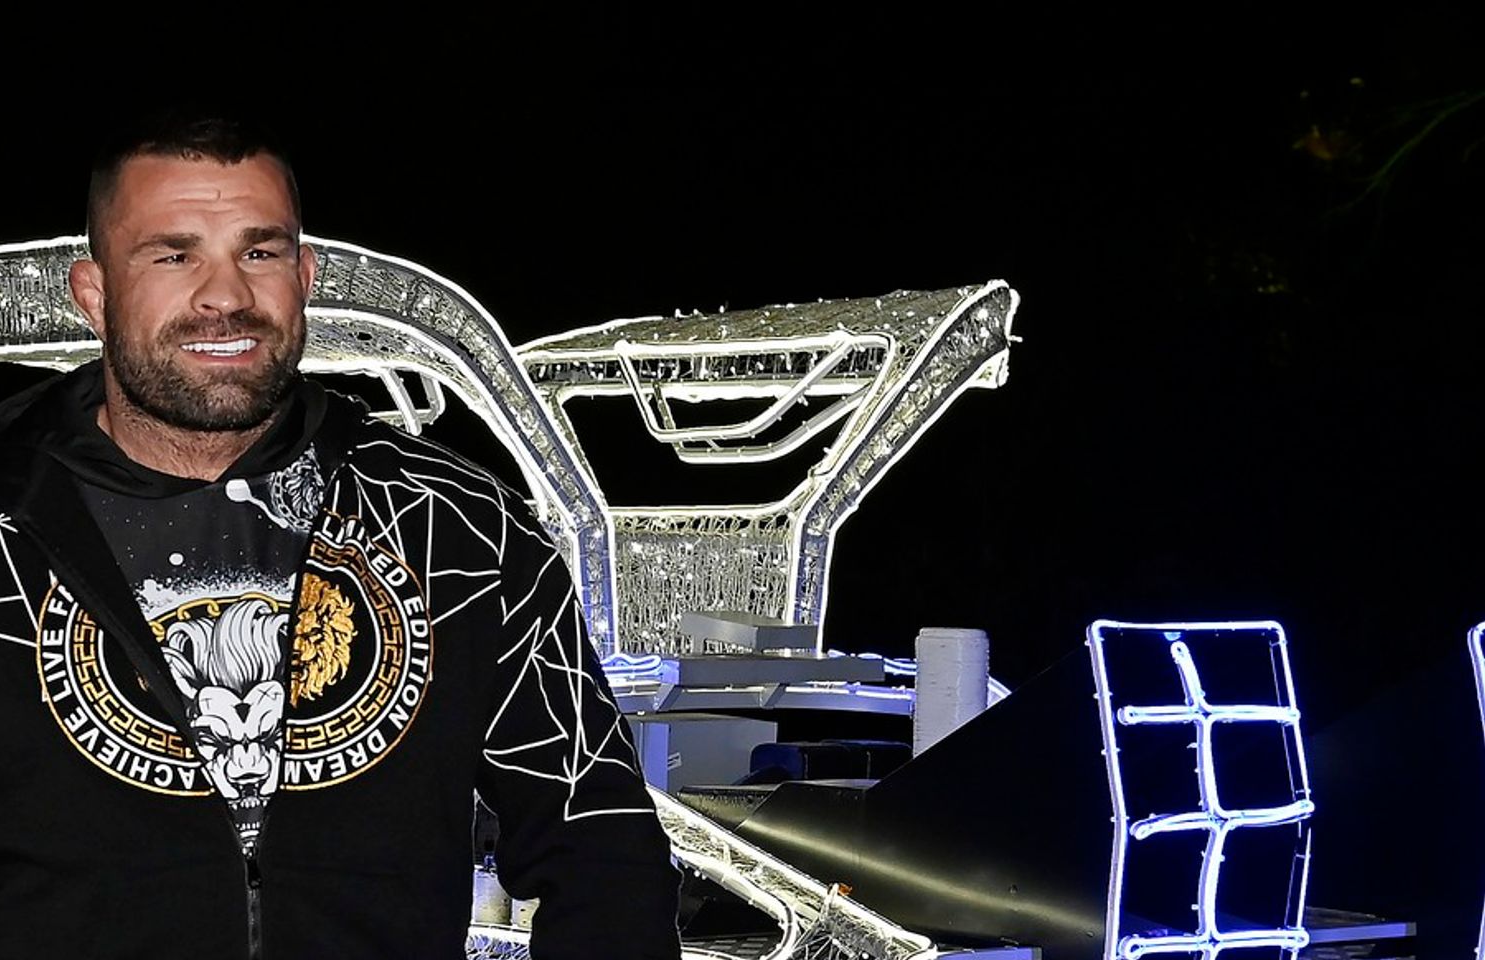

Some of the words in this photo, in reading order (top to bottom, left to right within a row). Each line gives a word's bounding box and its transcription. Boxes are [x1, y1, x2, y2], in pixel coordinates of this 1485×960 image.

[41, 628, 73, 703] LIVE
[388, 595, 430, 730] EDITION
[63, 705, 196, 790] ACHIEVE
